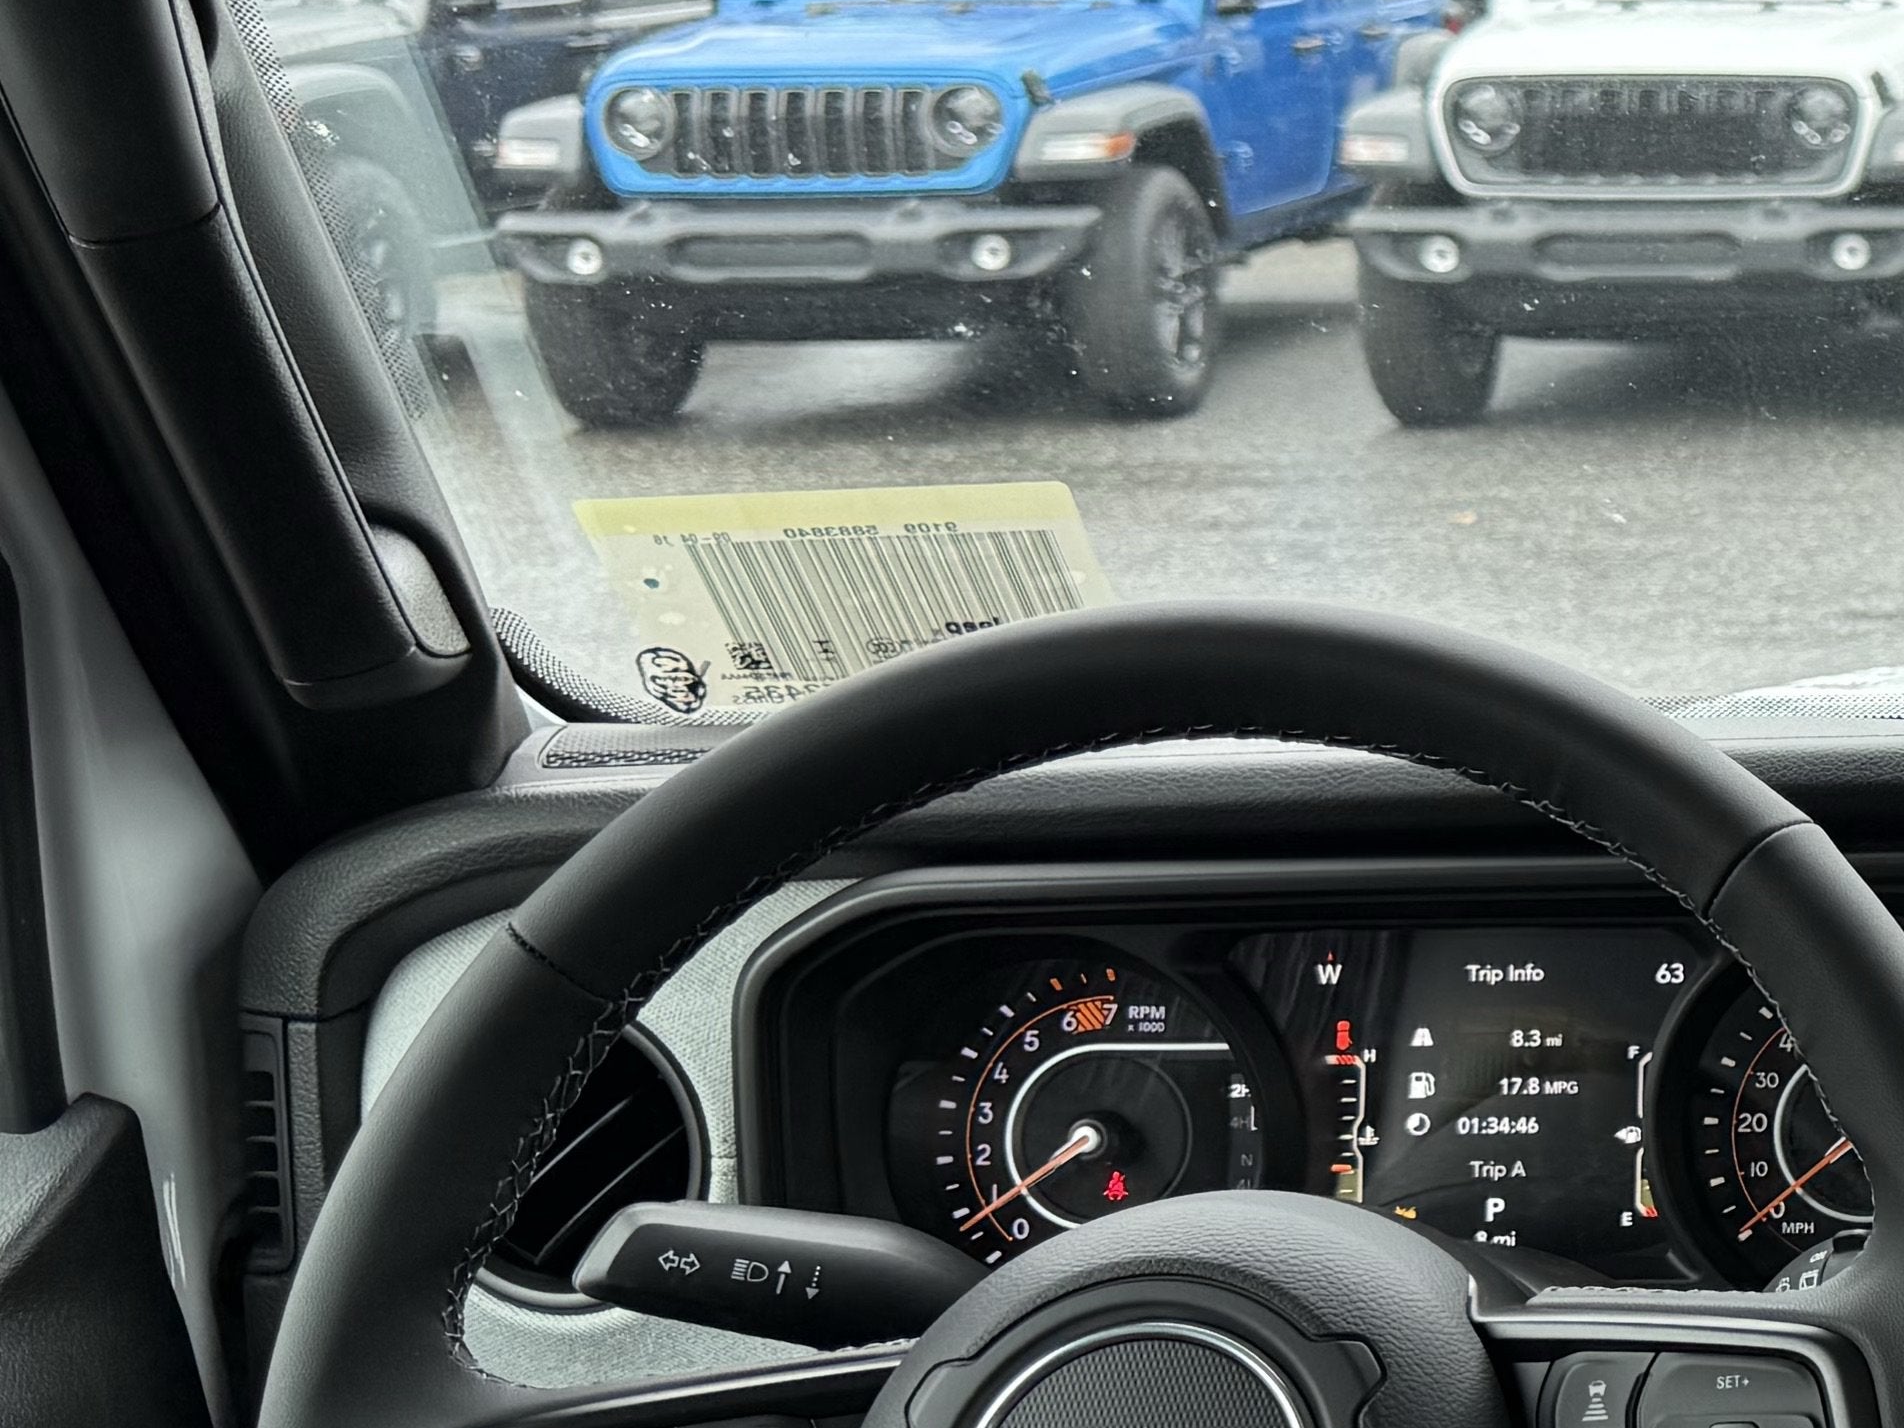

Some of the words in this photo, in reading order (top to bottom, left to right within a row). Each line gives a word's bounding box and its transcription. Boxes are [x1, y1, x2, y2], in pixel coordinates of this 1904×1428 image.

[1315, 964, 1342, 984] W
[1465, 965, 1504, 986] Trip
[1507, 964, 1545, 982] Info
[1655, 964, 1685, 984] 63
[1128, 1005, 1166, 1019] RPM
[1509, 1030, 1541, 1048] 8.3
[1546, 1033, 1563, 1047] mi
[1499, 1078, 1540, 1096] 17.8
[1545, 1081, 1579, 1095] MPG
[1755, 1072, 1779, 1089] 30
[1456, 1117, 1539, 1136] 01:34:46
[1738, 1114, 1768, 1132] 20
[1470, 1161, 1506, 1180] Trip
[1507, 1161, 1526, 1178] A
[1750, 1162, 1768, 1177] 10
[1486, 1198, 1505, 1222] P
[1782, 1222, 1815, 1234] MPH
